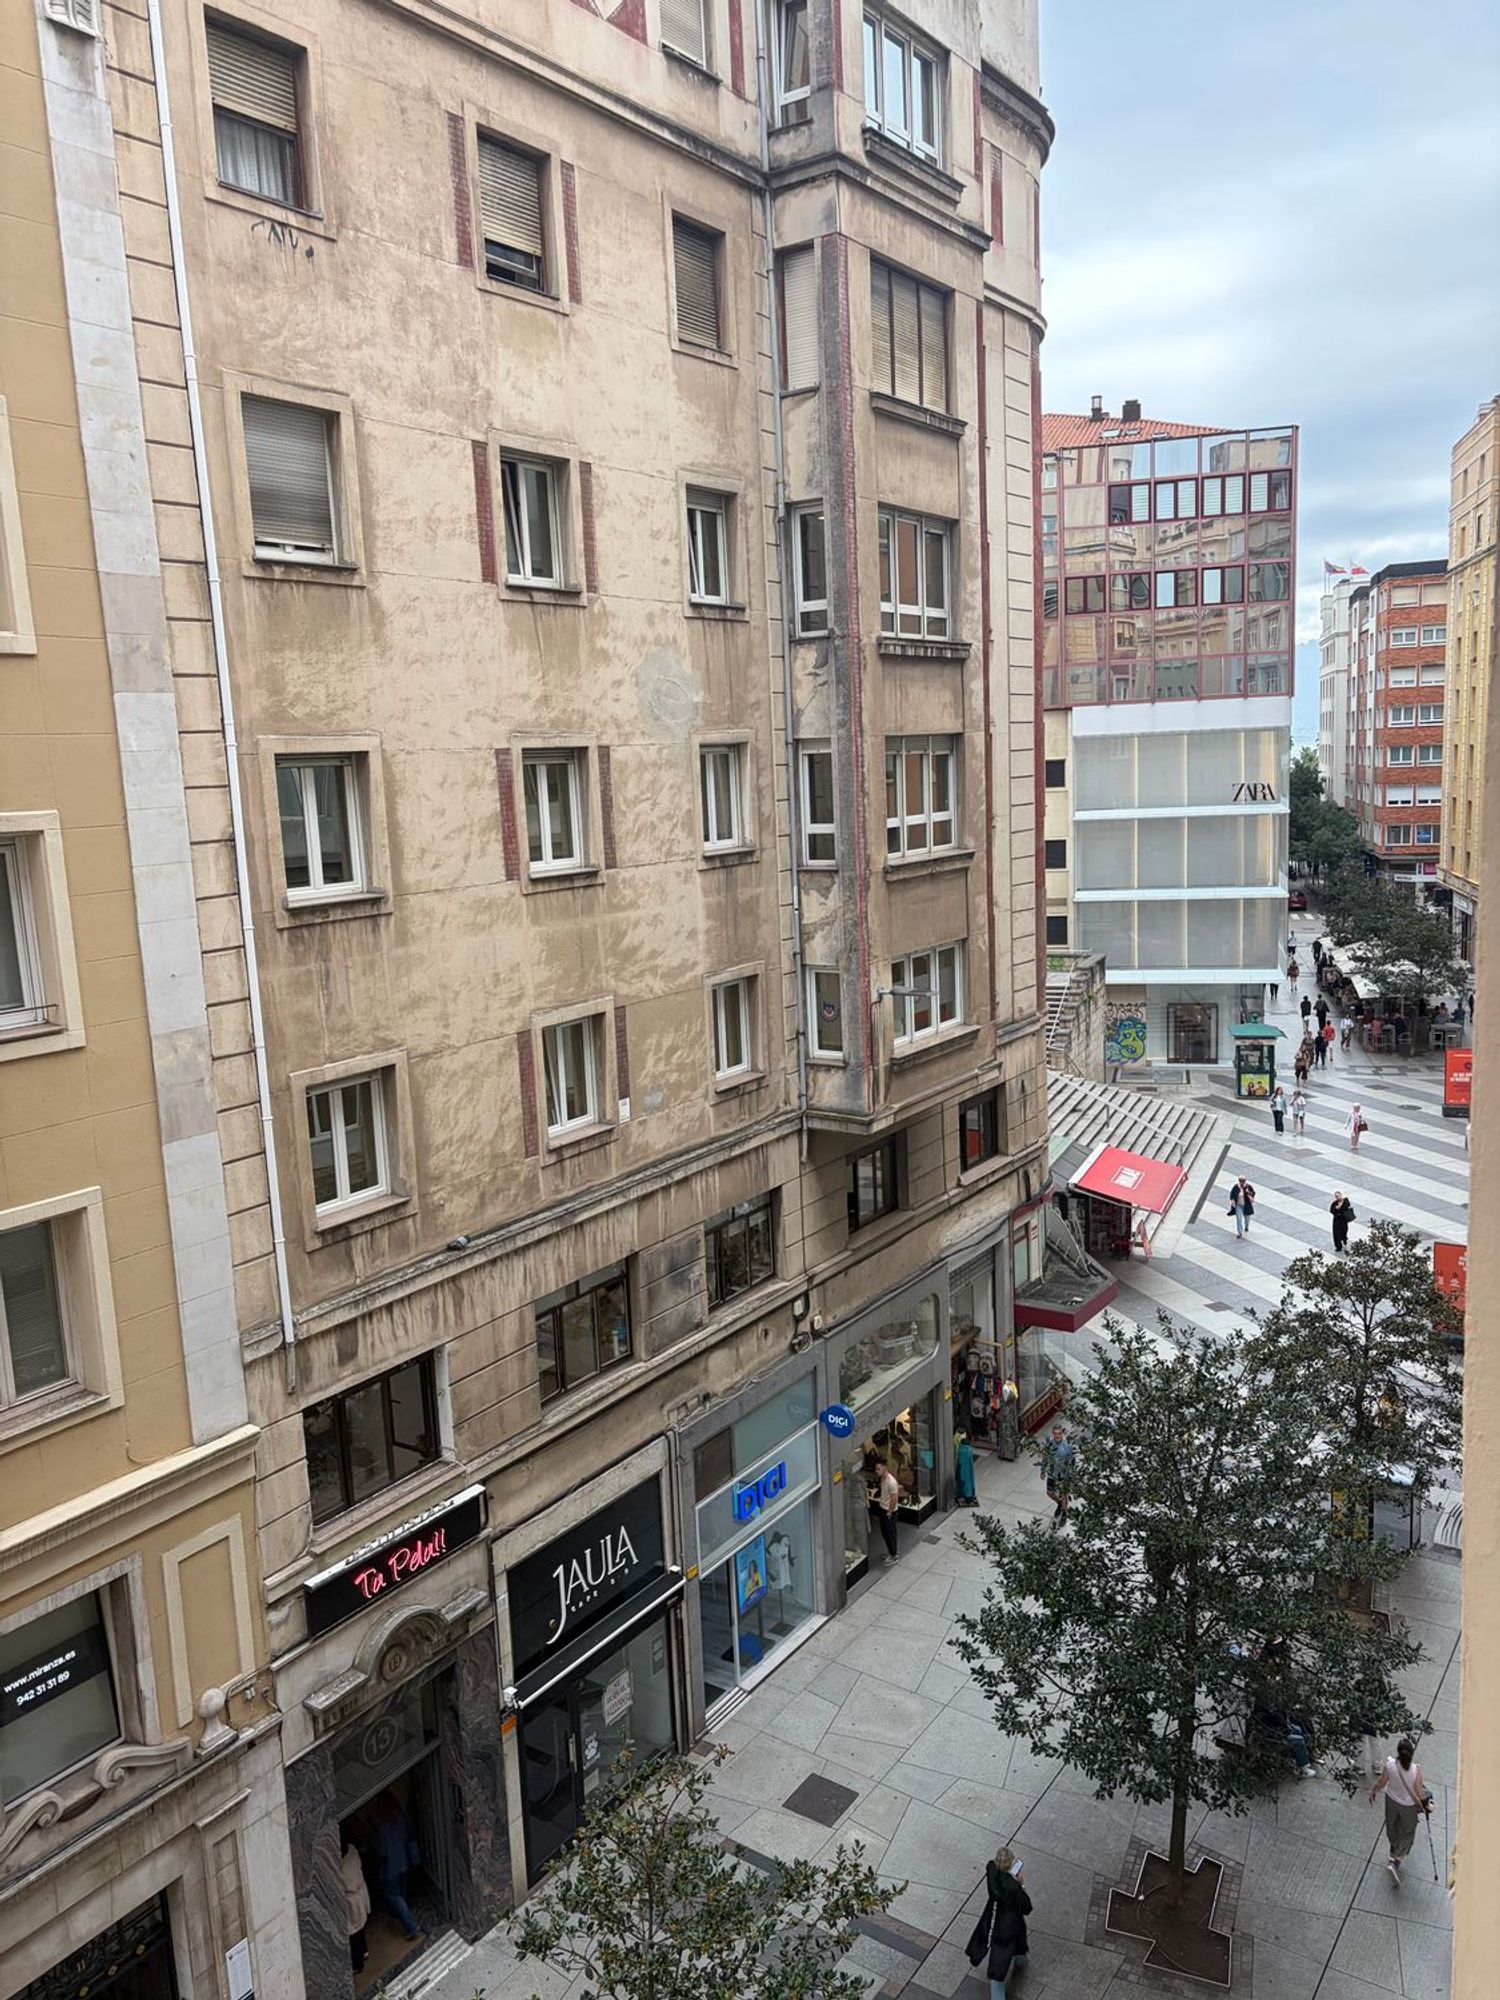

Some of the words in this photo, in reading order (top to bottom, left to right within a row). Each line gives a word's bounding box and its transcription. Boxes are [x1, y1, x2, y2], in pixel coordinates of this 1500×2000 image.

[1231, 783, 1275, 802] ZARA
[828, 1414, 848, 1427] DIGI
[737, 1461, 786, 1520] DIGI
[546, 1525, 639, 1644] JAULA
[4, 1650, 76, 1693] www.miranza.es
[16, 1689, 36, 1706] 942
[36, 1683, 47, 1695] 31
[47, 1677, 58, 1689] 31
[58, 1670, 70, 1683] 89
[368, 1729, 391, 1755] 13
